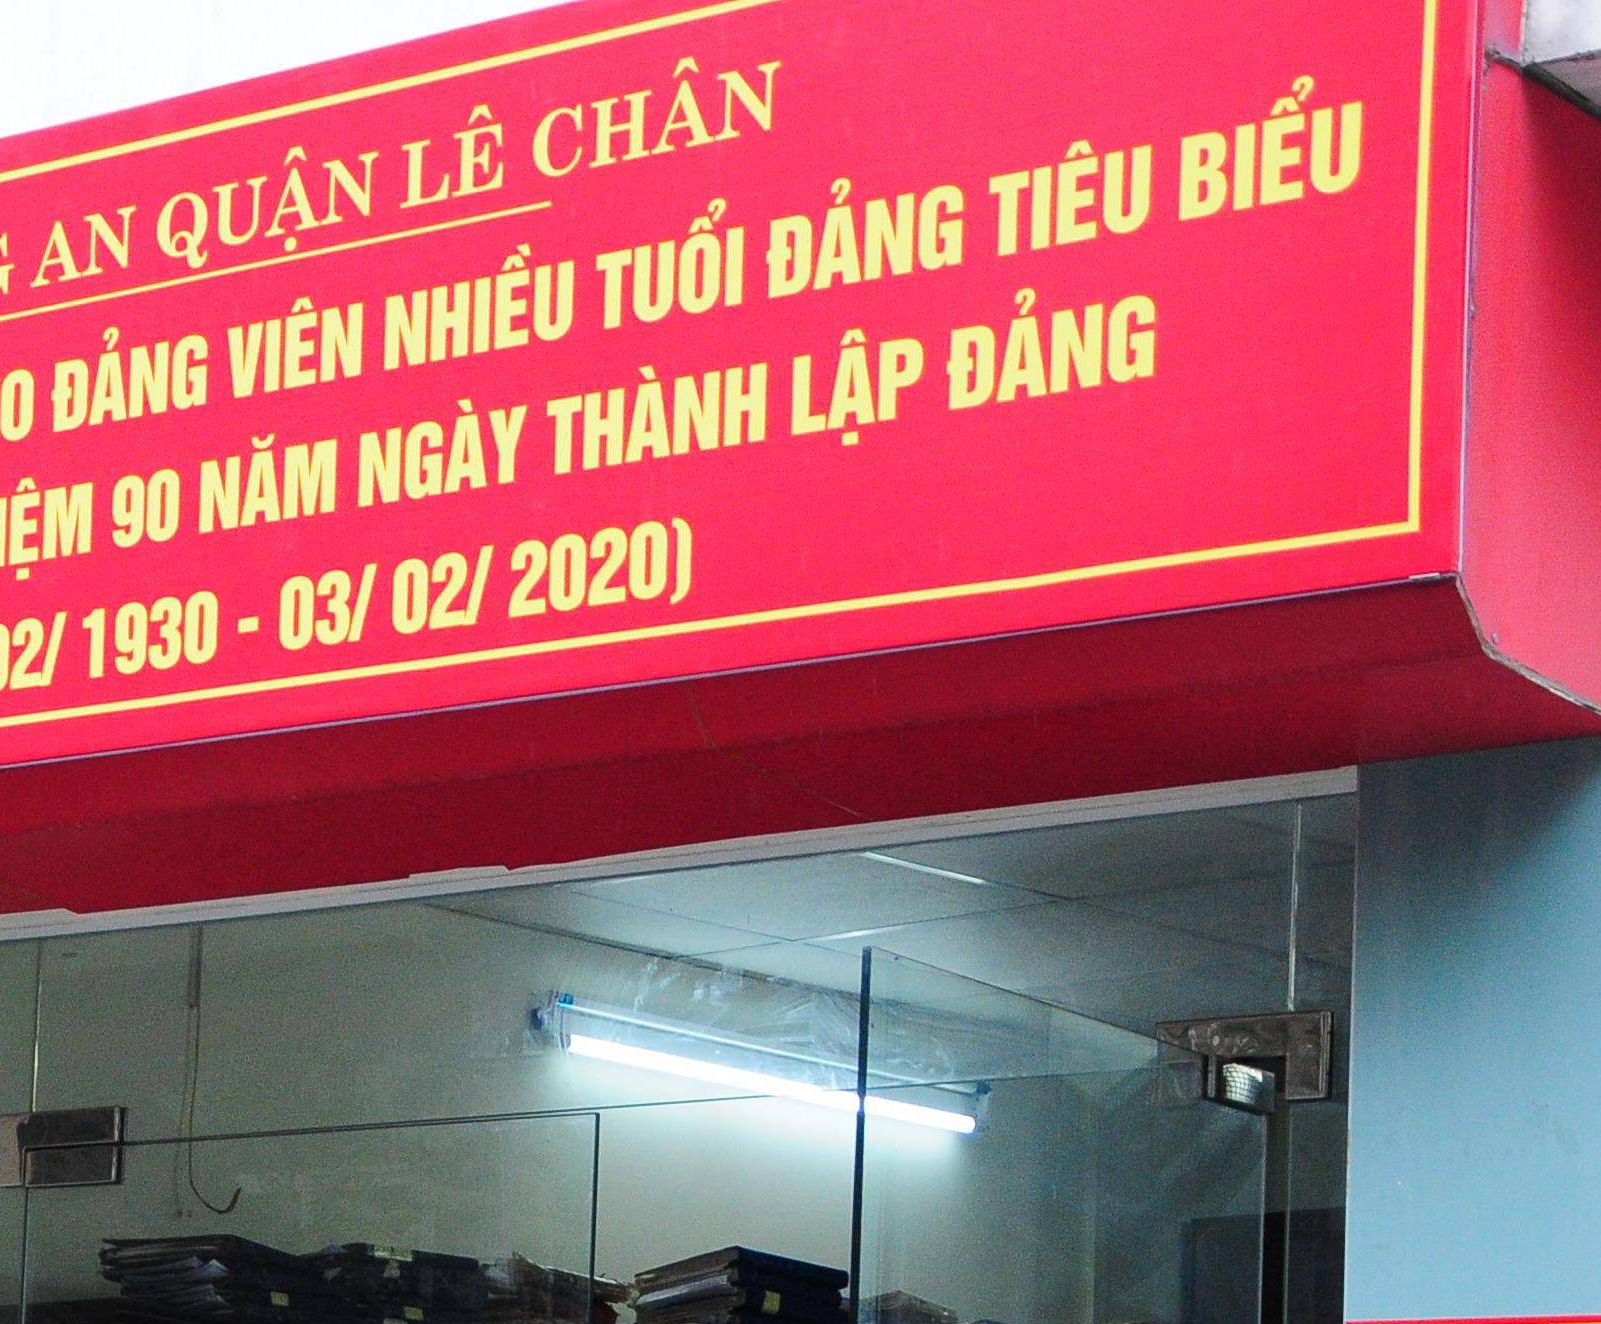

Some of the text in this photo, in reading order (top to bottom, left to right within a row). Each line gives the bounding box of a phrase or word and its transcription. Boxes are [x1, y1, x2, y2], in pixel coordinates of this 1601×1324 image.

[29, 205, 136, 289] AN
[156, 145, 379, 270] QUẬN
[399, 103, 504, 209] LÊ
[532, 56, 782, 178] CHÂN
[50, 326, 209, 433] ĐẢNG
[227, 296, 364, 399] VIÊN
[383, 242, 575, 371] NHIỀU
[595, 197, 745, 330] TUỔI
[765, 177, 965, 299] ĐẢNG
[988, 139, 1153, 257] TIÊU
[1178, 74, 1363, 222] BIỂU
[111, 468, 181, 548] 90
[198, 433, 338, 534] NĂM
[357, 398, 528, 508] NGÀY
[546, 362, 768, 475] THÀNH
[790, 327, 925, 447] LẬP
[946, 287, 1157, 411] ĐẢNG
[81, 590, 219, 679] 1930
[237, 616, 260, 634] -
[278, 562, 378, 651] 03/
[391, 544, 495, 635] 02/
[507, 516, 693, 619] 2020)
